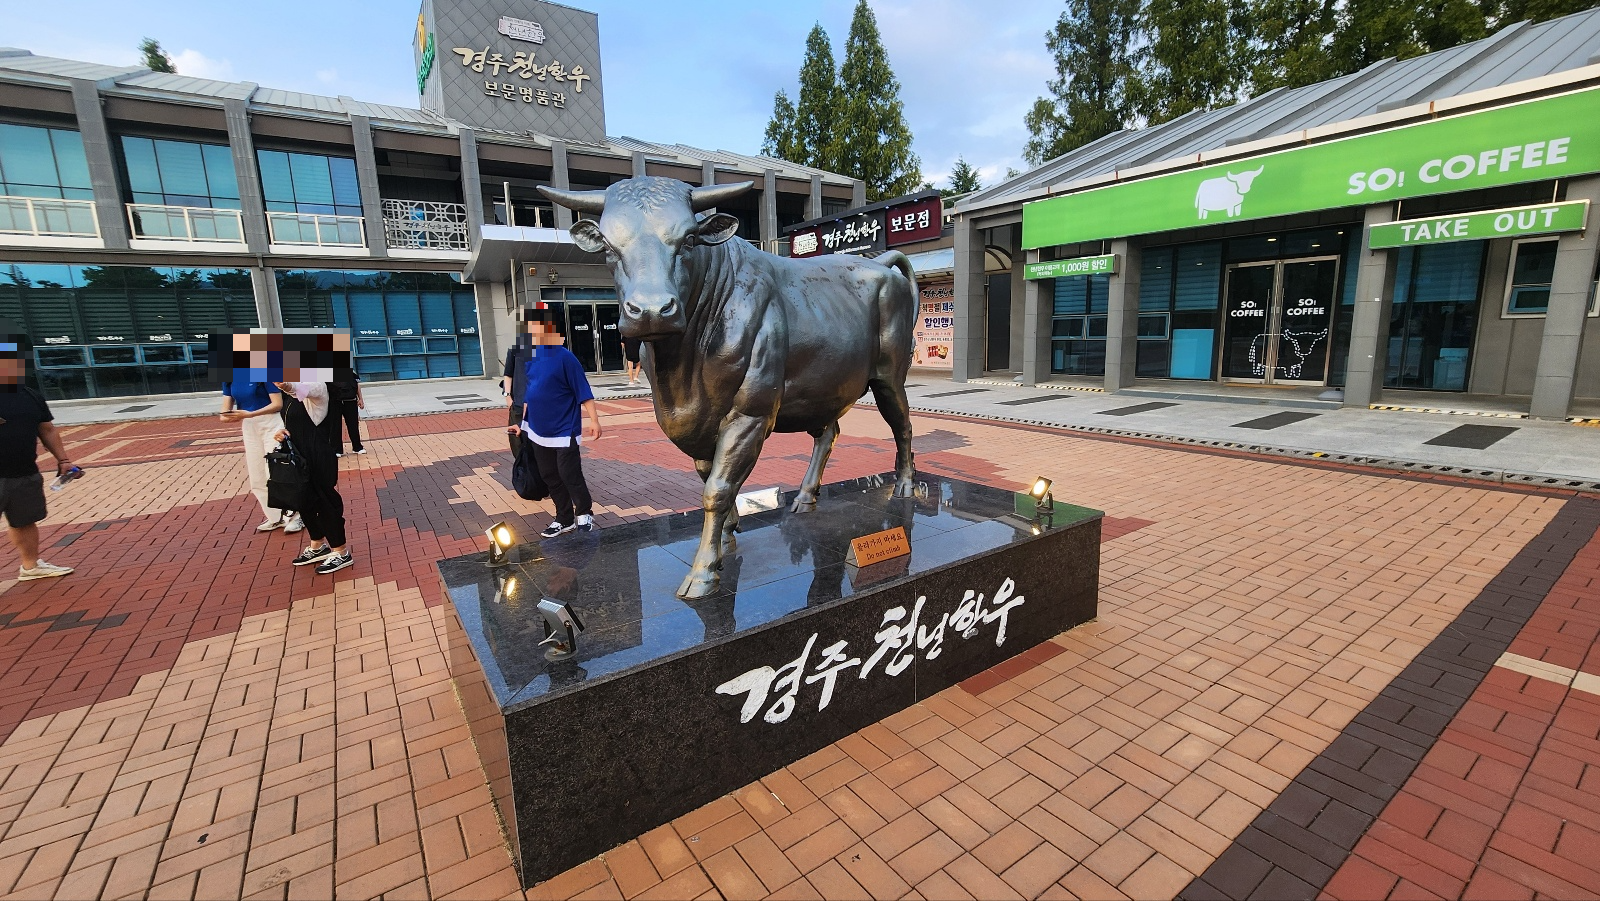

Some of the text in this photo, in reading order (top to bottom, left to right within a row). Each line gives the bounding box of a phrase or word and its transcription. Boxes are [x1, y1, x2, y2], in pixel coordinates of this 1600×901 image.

[484, 80, 566, 109] 보문명품관
[1347, 137, 1571, 195] SO! COFFEE
[891, 209, 930, 233] 보문점
[1401, 207, 1559, 242] TAKE OUT
[1061, 261, 1089, 274] 1,000원
[1091, 259, 1107, 270] 할인
[1230, 309, 1264, 317] COFFEE
[1286, 307, 1325, 316] COFFEE
[857, 537, 883, 551] 올라가지
[886, 545, 901, 554] climb
